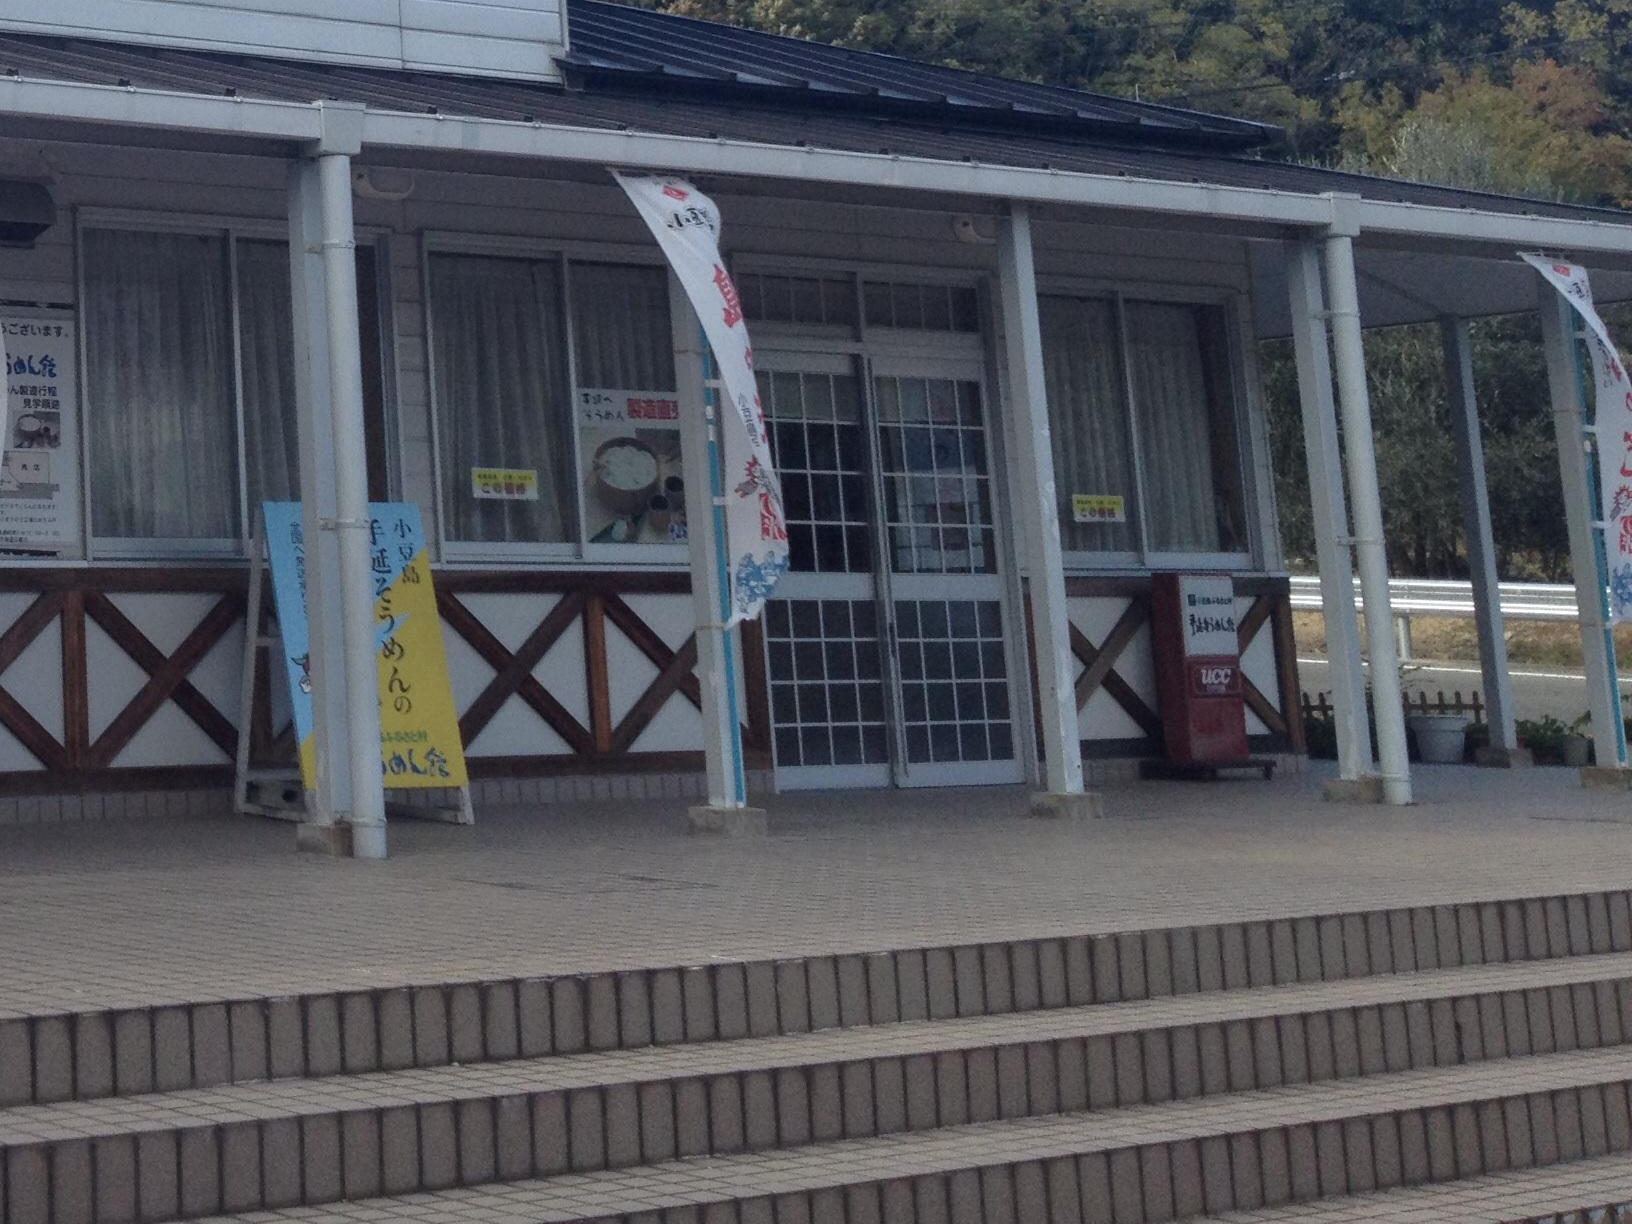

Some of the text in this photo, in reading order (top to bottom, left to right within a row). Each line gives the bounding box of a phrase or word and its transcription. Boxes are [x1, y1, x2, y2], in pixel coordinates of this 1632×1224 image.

[394, 518, 421, 584] 小豆島
[1201, 668, 1231, 684] UCC
